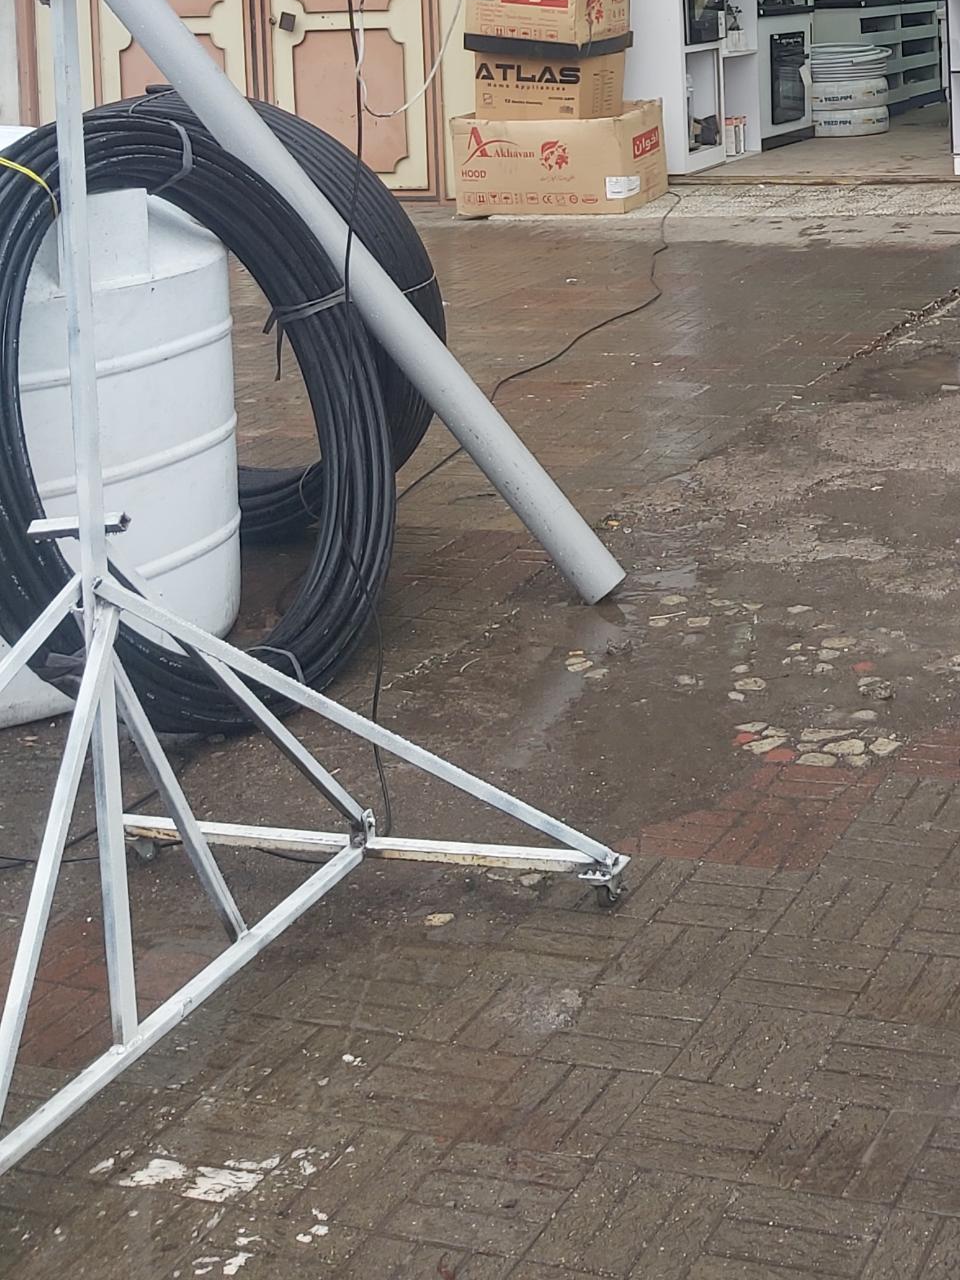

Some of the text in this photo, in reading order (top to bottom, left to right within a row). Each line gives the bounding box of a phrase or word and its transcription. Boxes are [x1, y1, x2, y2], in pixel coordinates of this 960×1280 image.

[475, 62, 581, 85] ATLAS
[633, 129, 660, 156] اخوان
[493, 147, 535, 159] Akhavan
[461, 169, 487, 178] HOOD
